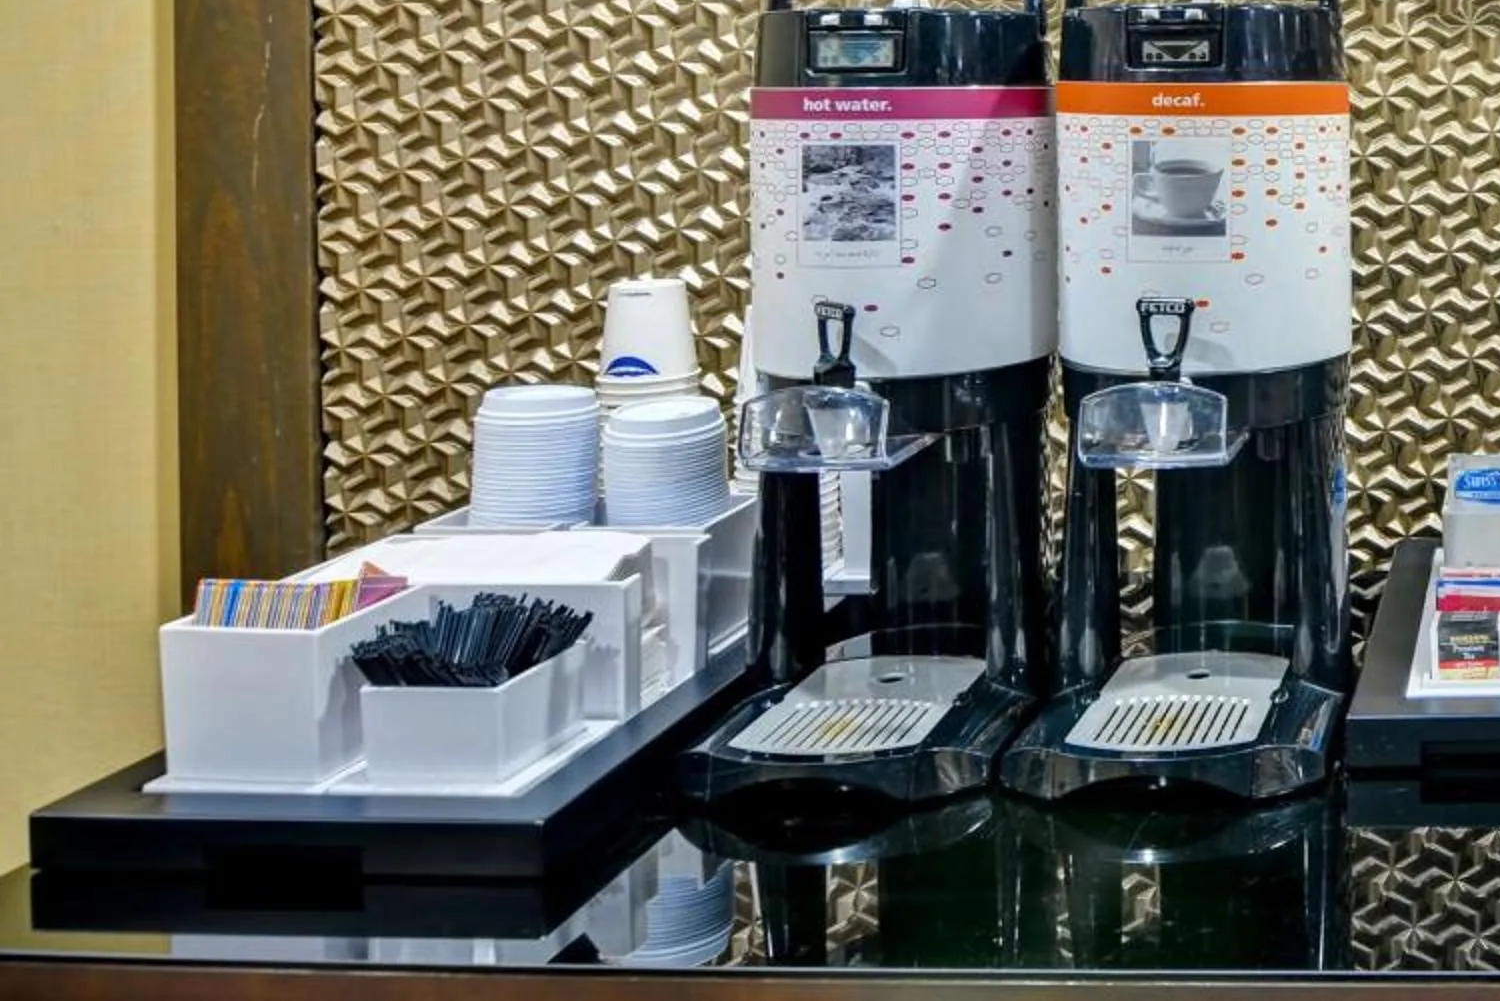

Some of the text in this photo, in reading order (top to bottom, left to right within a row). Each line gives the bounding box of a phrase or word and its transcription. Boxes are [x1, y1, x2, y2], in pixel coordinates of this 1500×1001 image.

[803, 97, 893, 112] hot water.
[1151, 92, 1206, 108] decaf.
